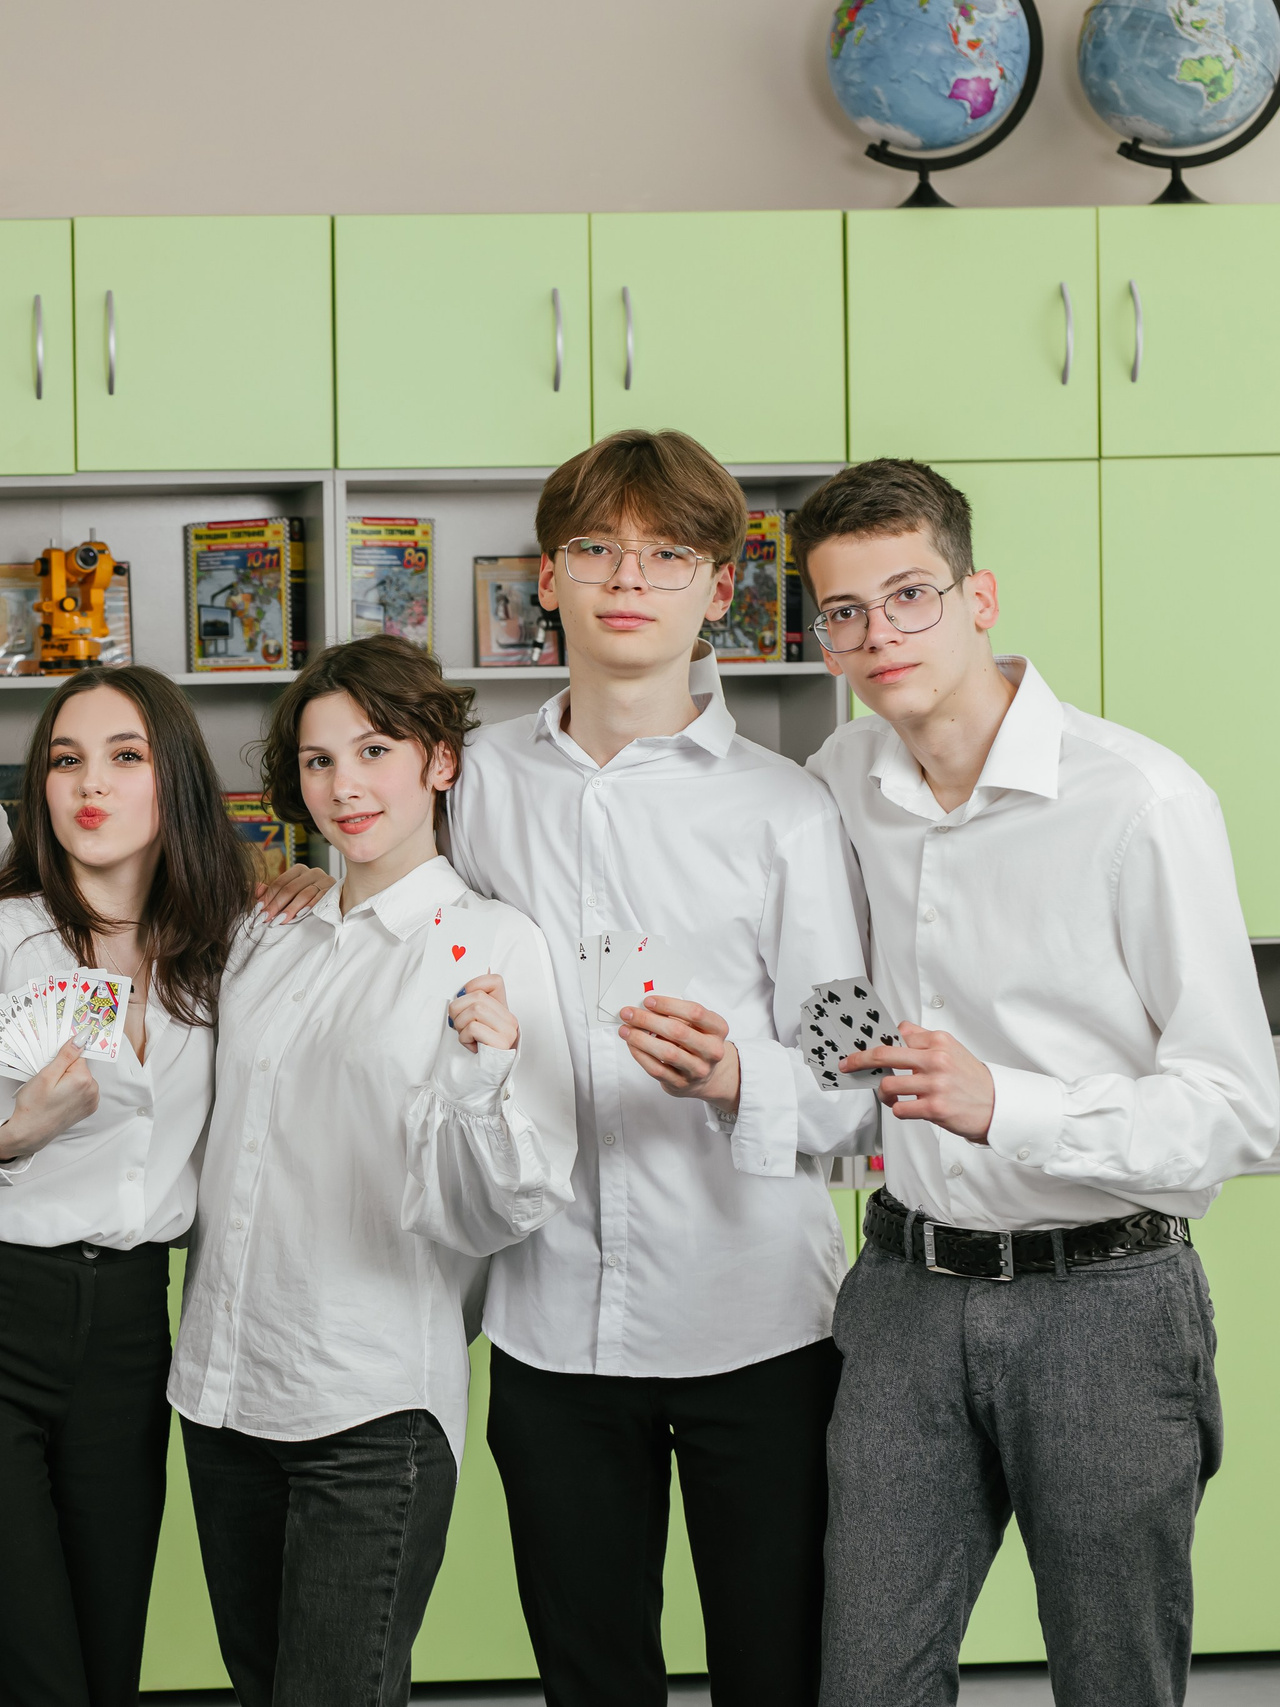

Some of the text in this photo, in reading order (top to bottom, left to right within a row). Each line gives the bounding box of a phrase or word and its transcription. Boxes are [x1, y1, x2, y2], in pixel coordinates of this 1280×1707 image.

[261, 825, 280, 851] 7
[435, 907, 442, 918] A
[604, 935, 611, 945] A
[640, 937, 648, 947] A
[579, 943, 586, 953] A
[48, 975, 54, 985] Q
[73, 972, 79, 983] Q
[814, 988, 822, 997] 7
[804, 1005, 813, 1015] 7
